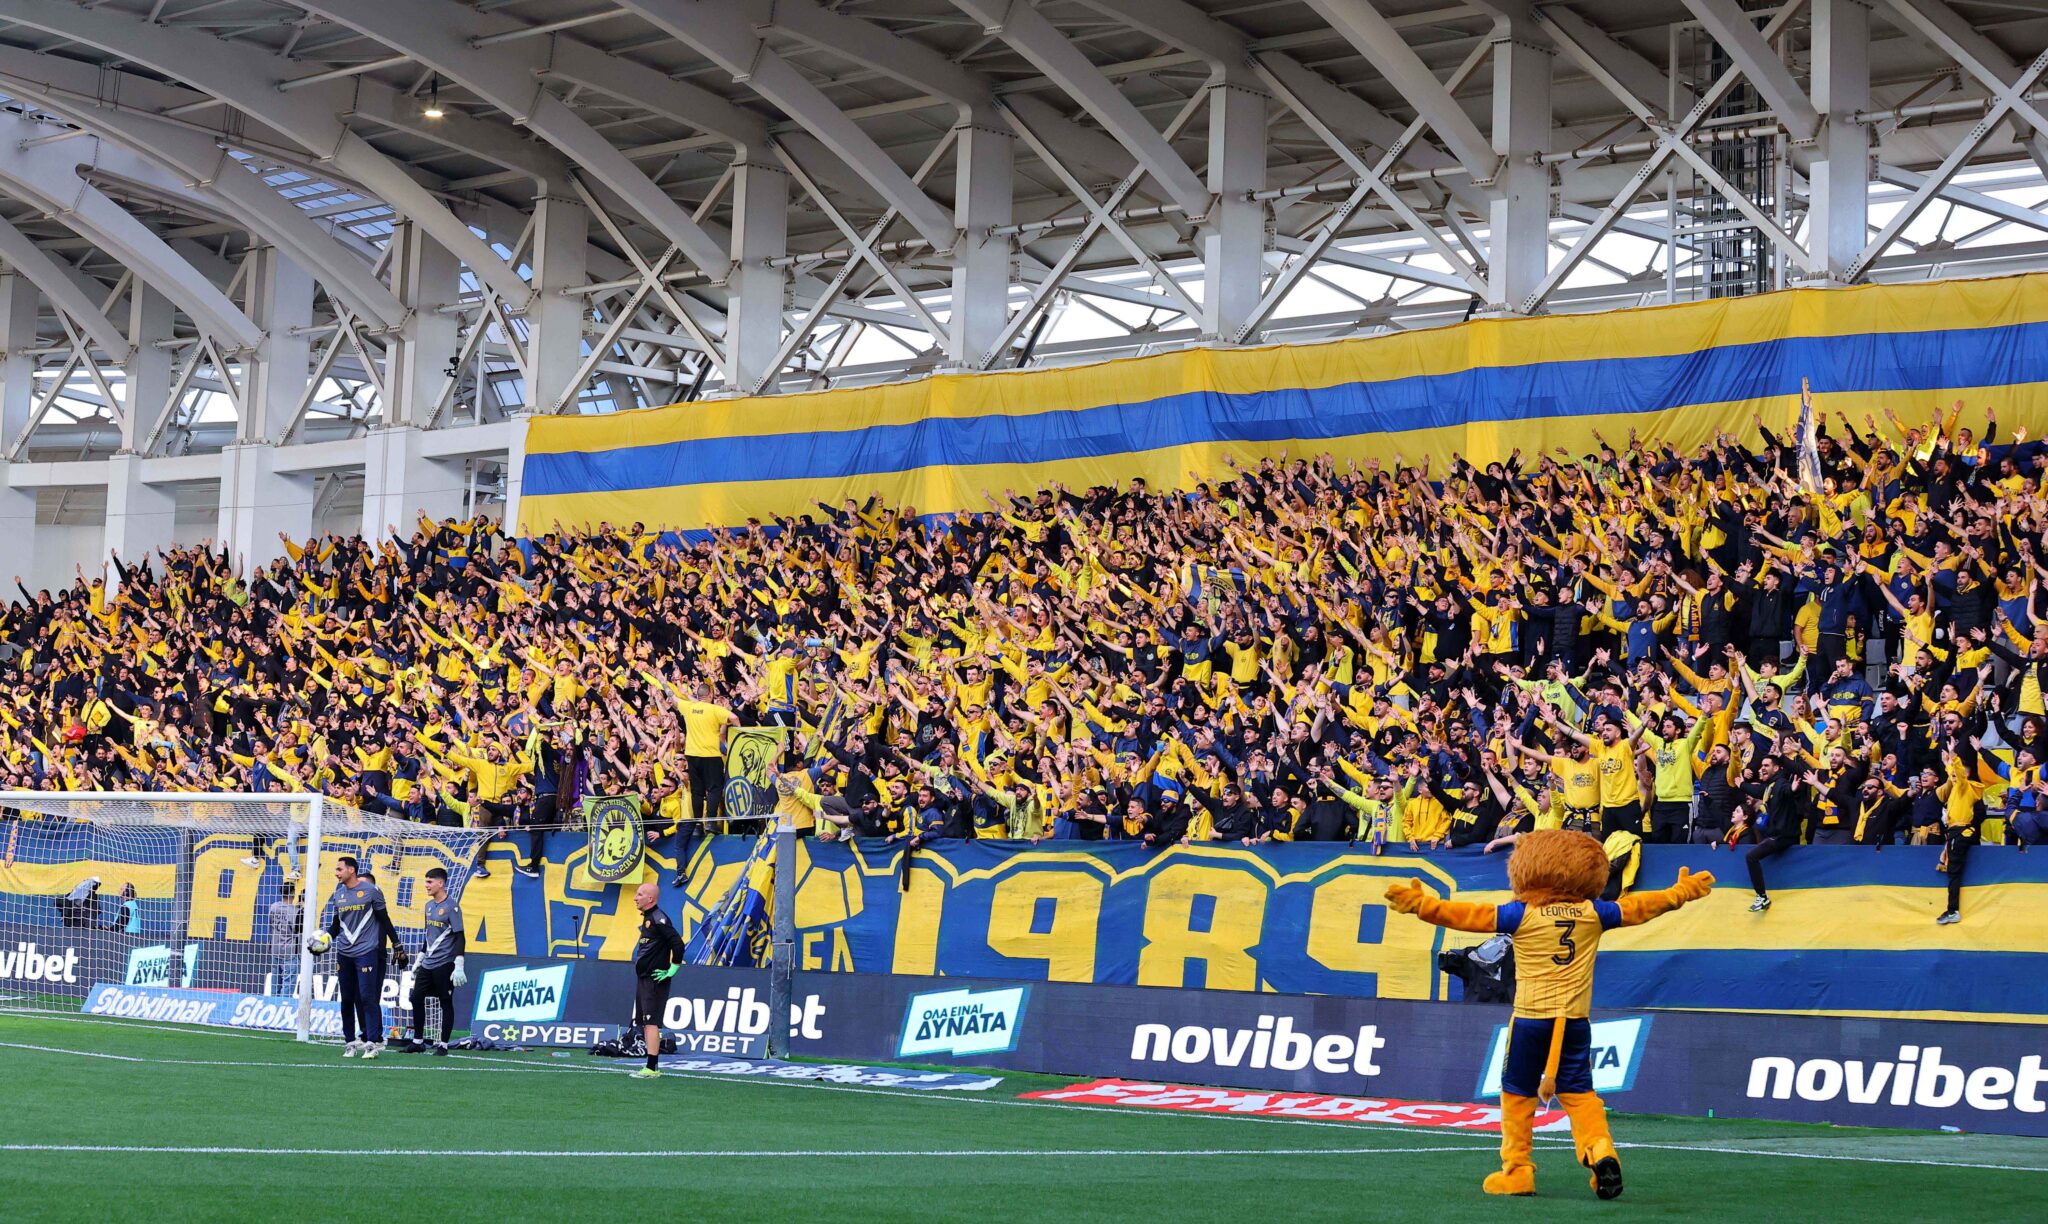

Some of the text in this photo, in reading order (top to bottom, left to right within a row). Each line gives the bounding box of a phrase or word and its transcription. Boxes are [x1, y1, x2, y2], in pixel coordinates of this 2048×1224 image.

[1540, 906, 1583, 918] LEONTAS
[1552, 920, 1576, 965] 3
[486, 986, 555, 1012] ΔΥΝΑΤΑ
[492, 979, 538, 994] ΟΛΑ ΕΙΝΑΙ
[91, 986, 217, 1023] Stoiximan
[923, 1003, 984, 1020] ΟΛΑ ΕΙΝΑΙ
[915, 1011, 1007, 1041] ΔΥΝΑΤΑ
[1131, 1014, 1386, 1077] novibet
[1746, 1044, 2048, 1113] novibet
